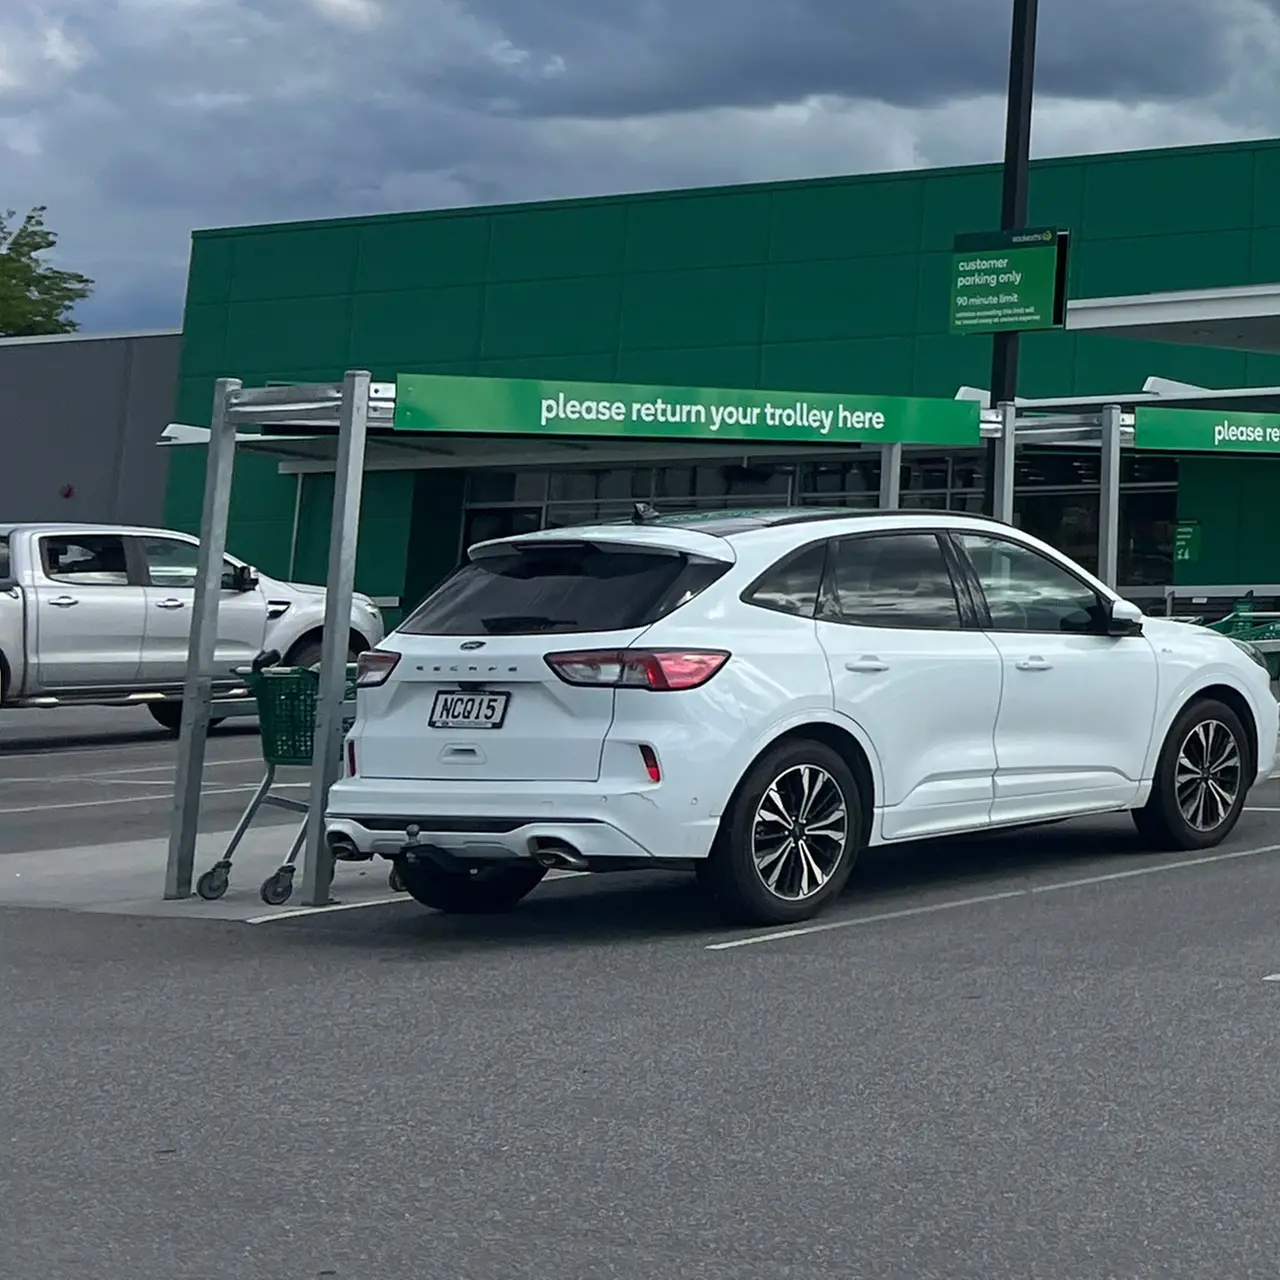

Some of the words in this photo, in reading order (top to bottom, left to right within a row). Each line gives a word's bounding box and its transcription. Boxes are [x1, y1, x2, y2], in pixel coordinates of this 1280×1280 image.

[958, 258, 1009, 271] customer
[957, 273, 997, 288] parking
[999, 270, 1022, 286] only
[956, 296, 968, 307] 90
[968, 295, 998, 306] minute
[999, 293, 1018, 303] limit
[541, 392, 626, 426] please
[631, 399, 706, 424] return
[709, 405, 762, 431] your
[764, 402, 834, 434] trolley
[838, 404, 885, 430] here
[1214, 420, 1263, 445] please
[439, 697, 499, 720] NCQ15
